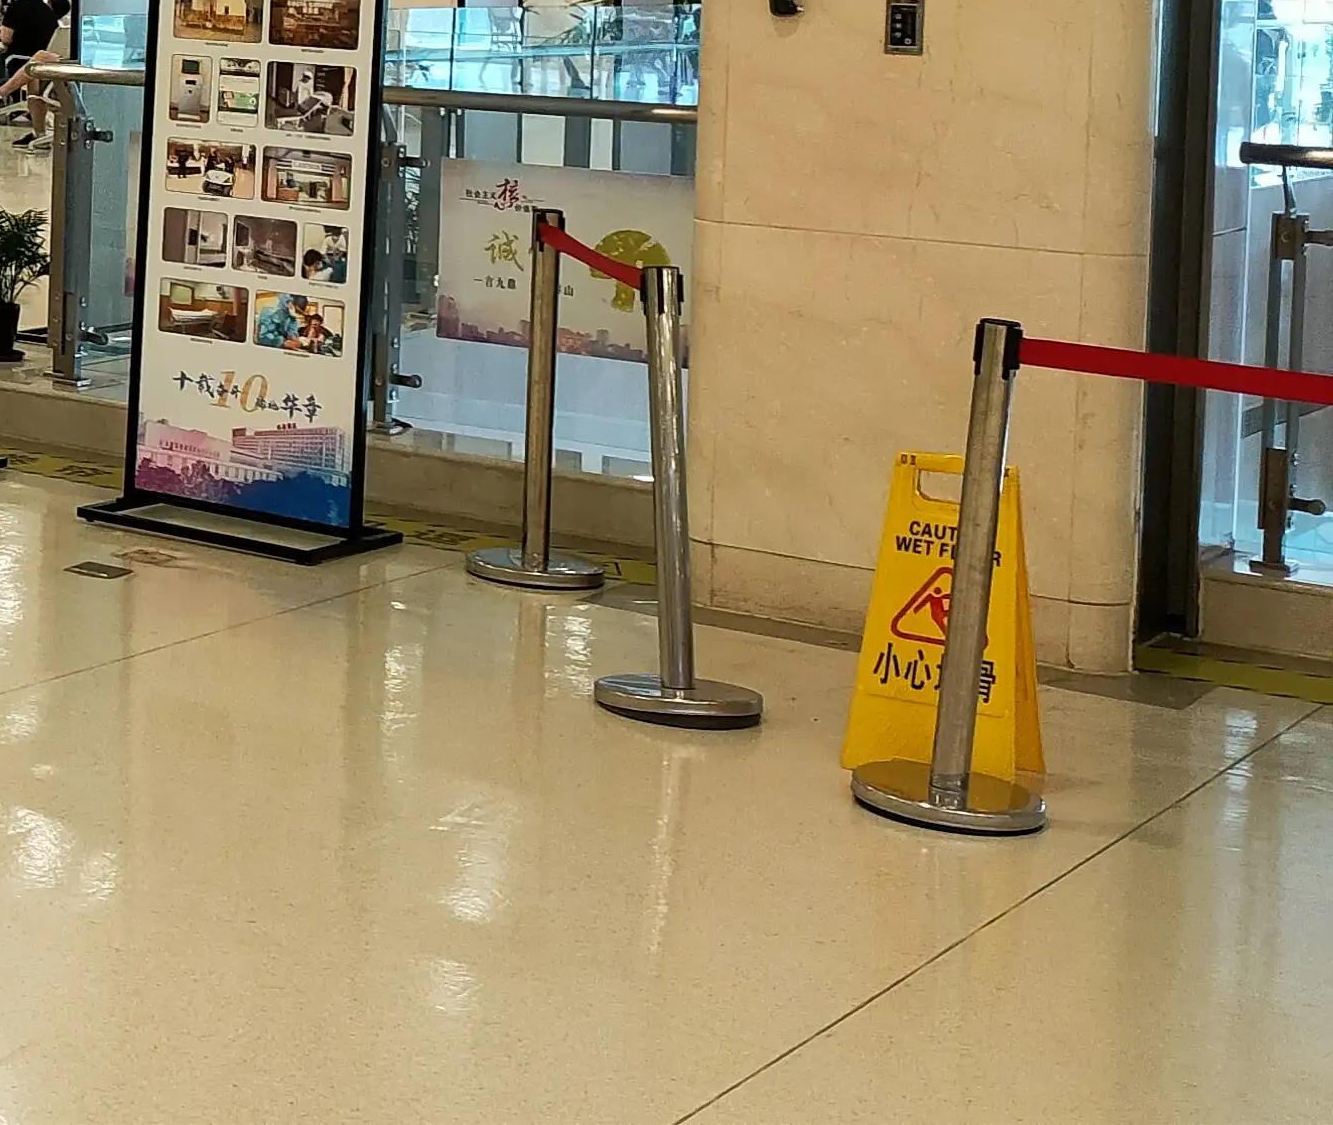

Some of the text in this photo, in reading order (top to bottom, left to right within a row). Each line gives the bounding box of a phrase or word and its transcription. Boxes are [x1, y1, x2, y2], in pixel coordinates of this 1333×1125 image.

[208, 369, 268, 413] 10
[909, 520, 958, 542] CAUT
[896, 535, 1002, 568] WET FLR
[873, 641, 997, 704] 小心滑
